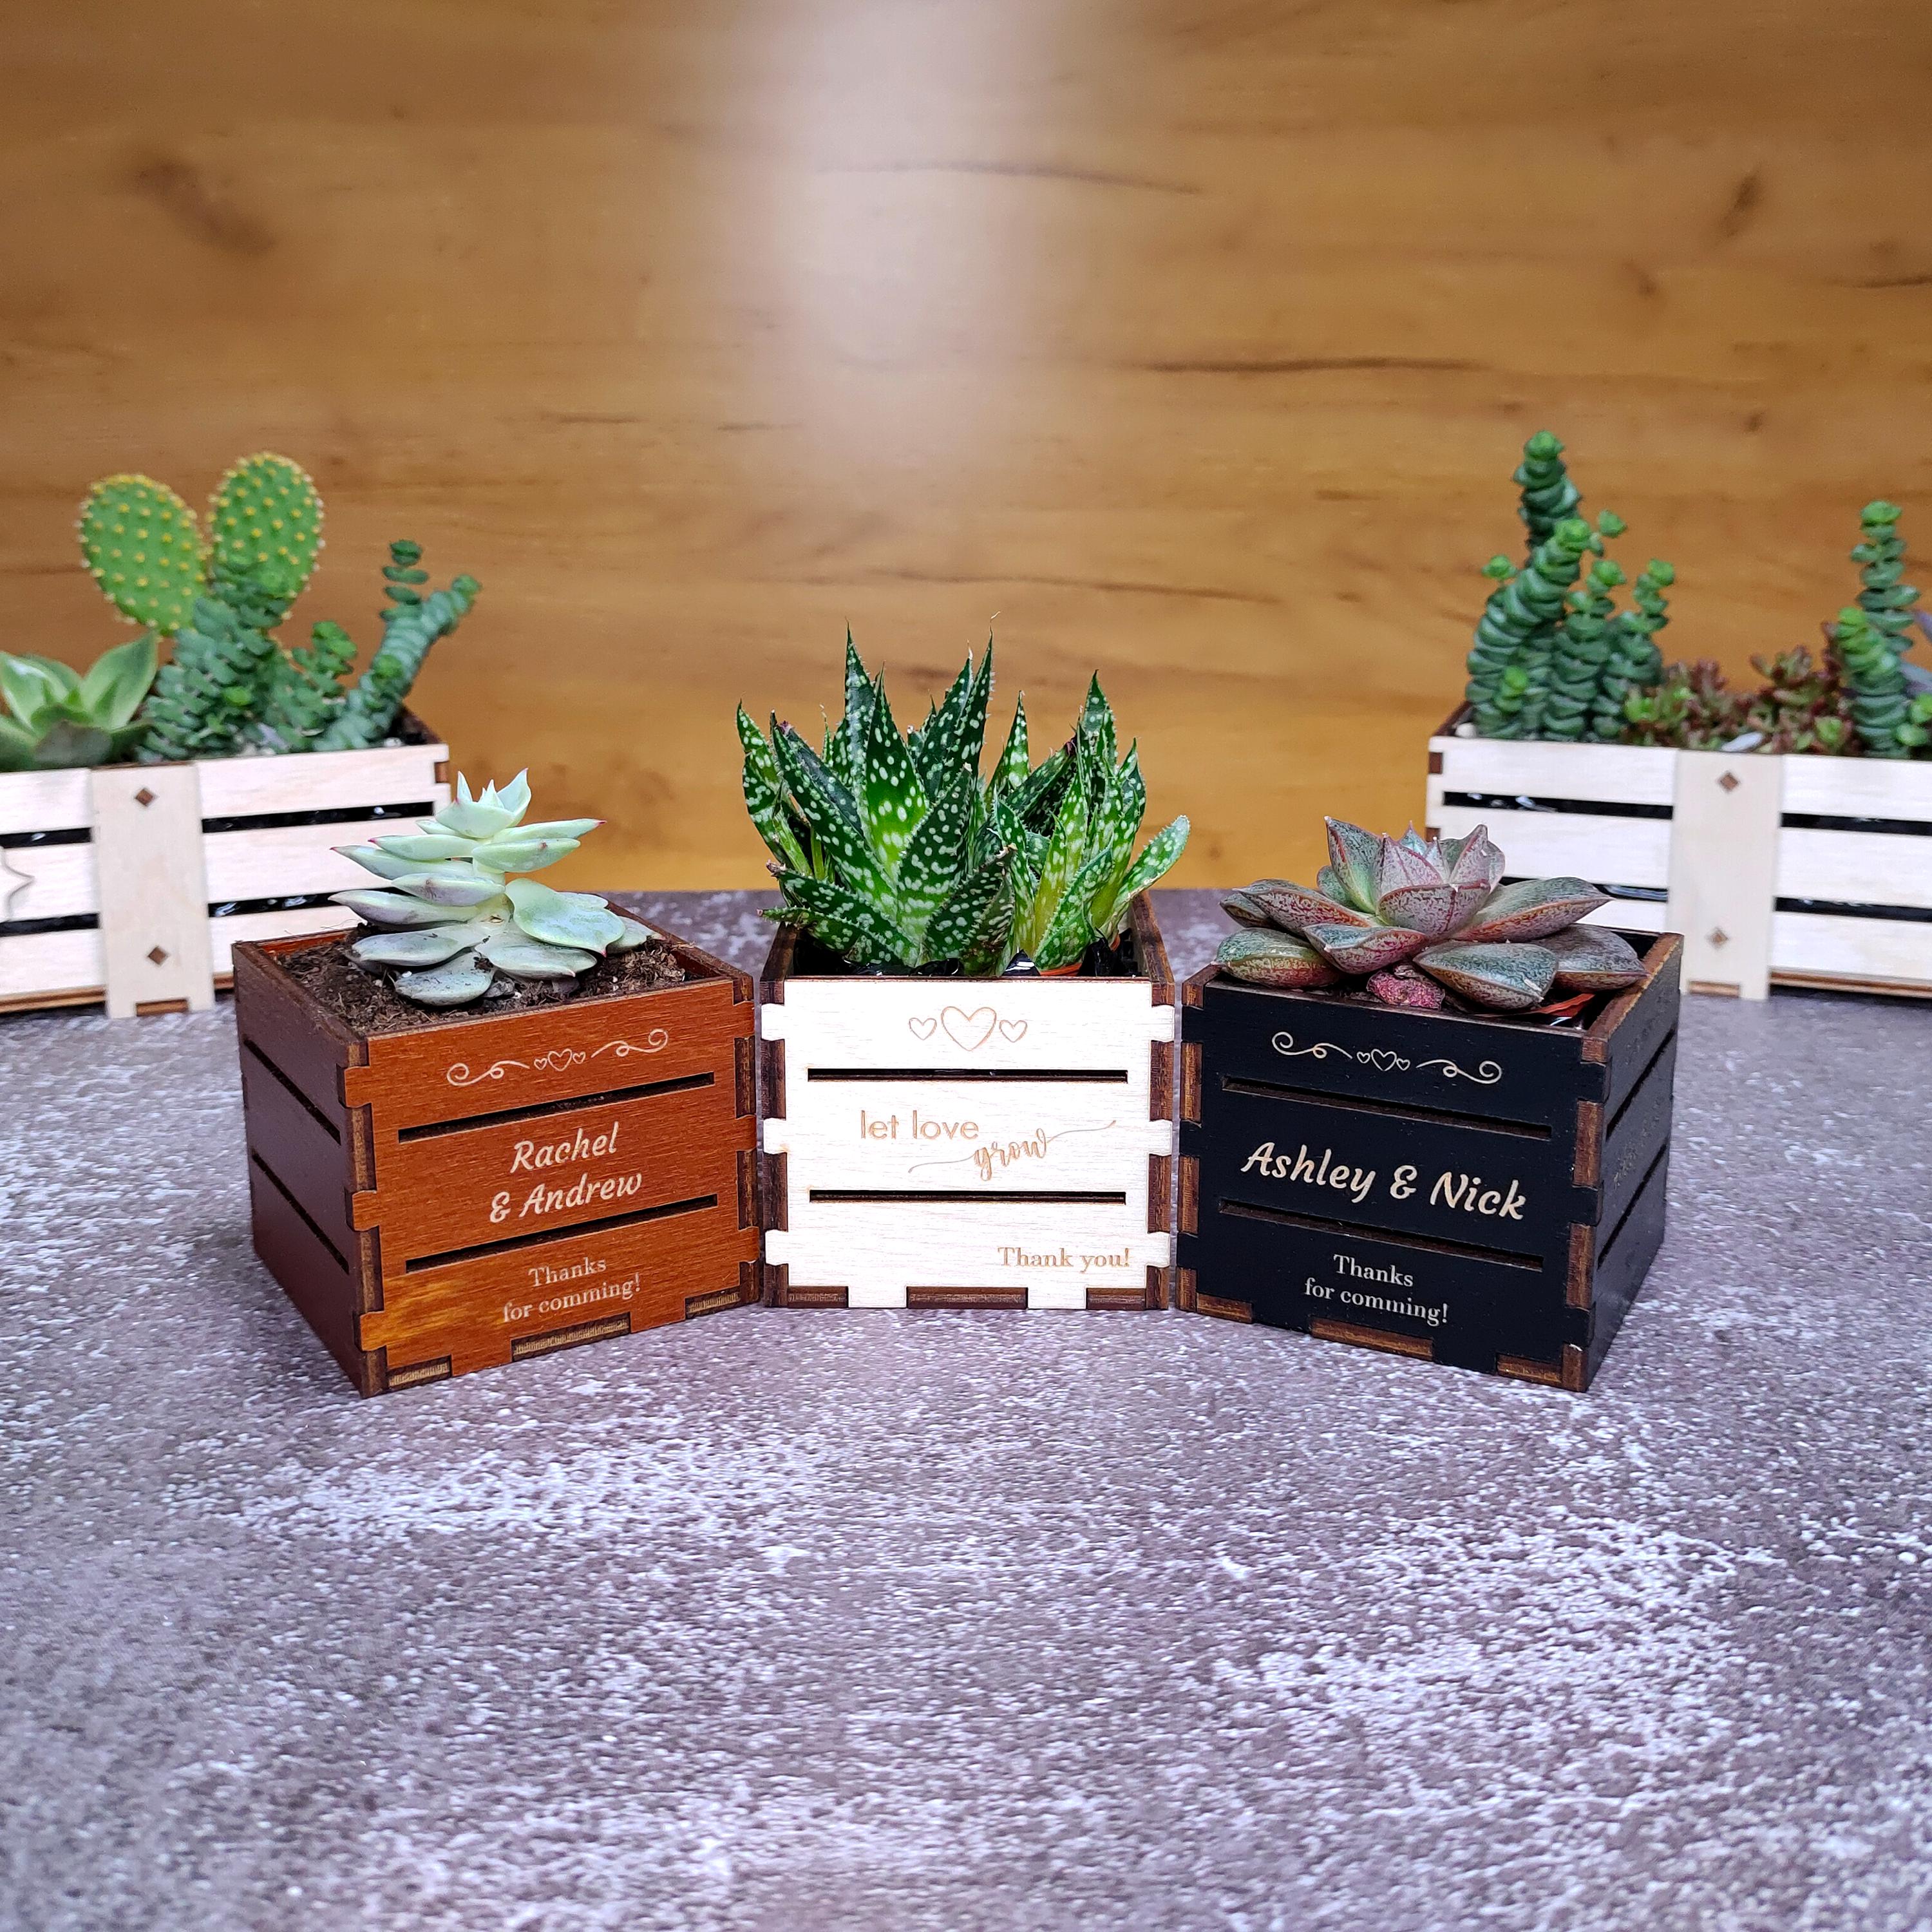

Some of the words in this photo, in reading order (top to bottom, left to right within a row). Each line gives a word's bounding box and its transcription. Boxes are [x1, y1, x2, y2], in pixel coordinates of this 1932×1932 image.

[509, 1121, 620, 1173] Rachel
[860, 1109, 899, 1141] let
[912, 1109, 980, 1141] love
[489, 1191, 511, 1224] &
[519, 1172, 643, 1218] Andrew
[1240, 1141, 1376, 1204] Ashley
[1389, 1164, 1417, 1199] &
[1429, 1171, 1527, 1221] Nick
[527, 1256, 607, 1287] Thanks
[998, 1247, 1074, 1268] Thank
[1080, 1247, 1130, 1274] you!
[1333, 1253, 1414, 1287] Thanks
[502, 1300, 533, 1323] for
[538, 1273, 641, 1314] comming!
[1304, 1276, 1335, 1302] for
[1340, 1289, 1450, 1327] comming!
